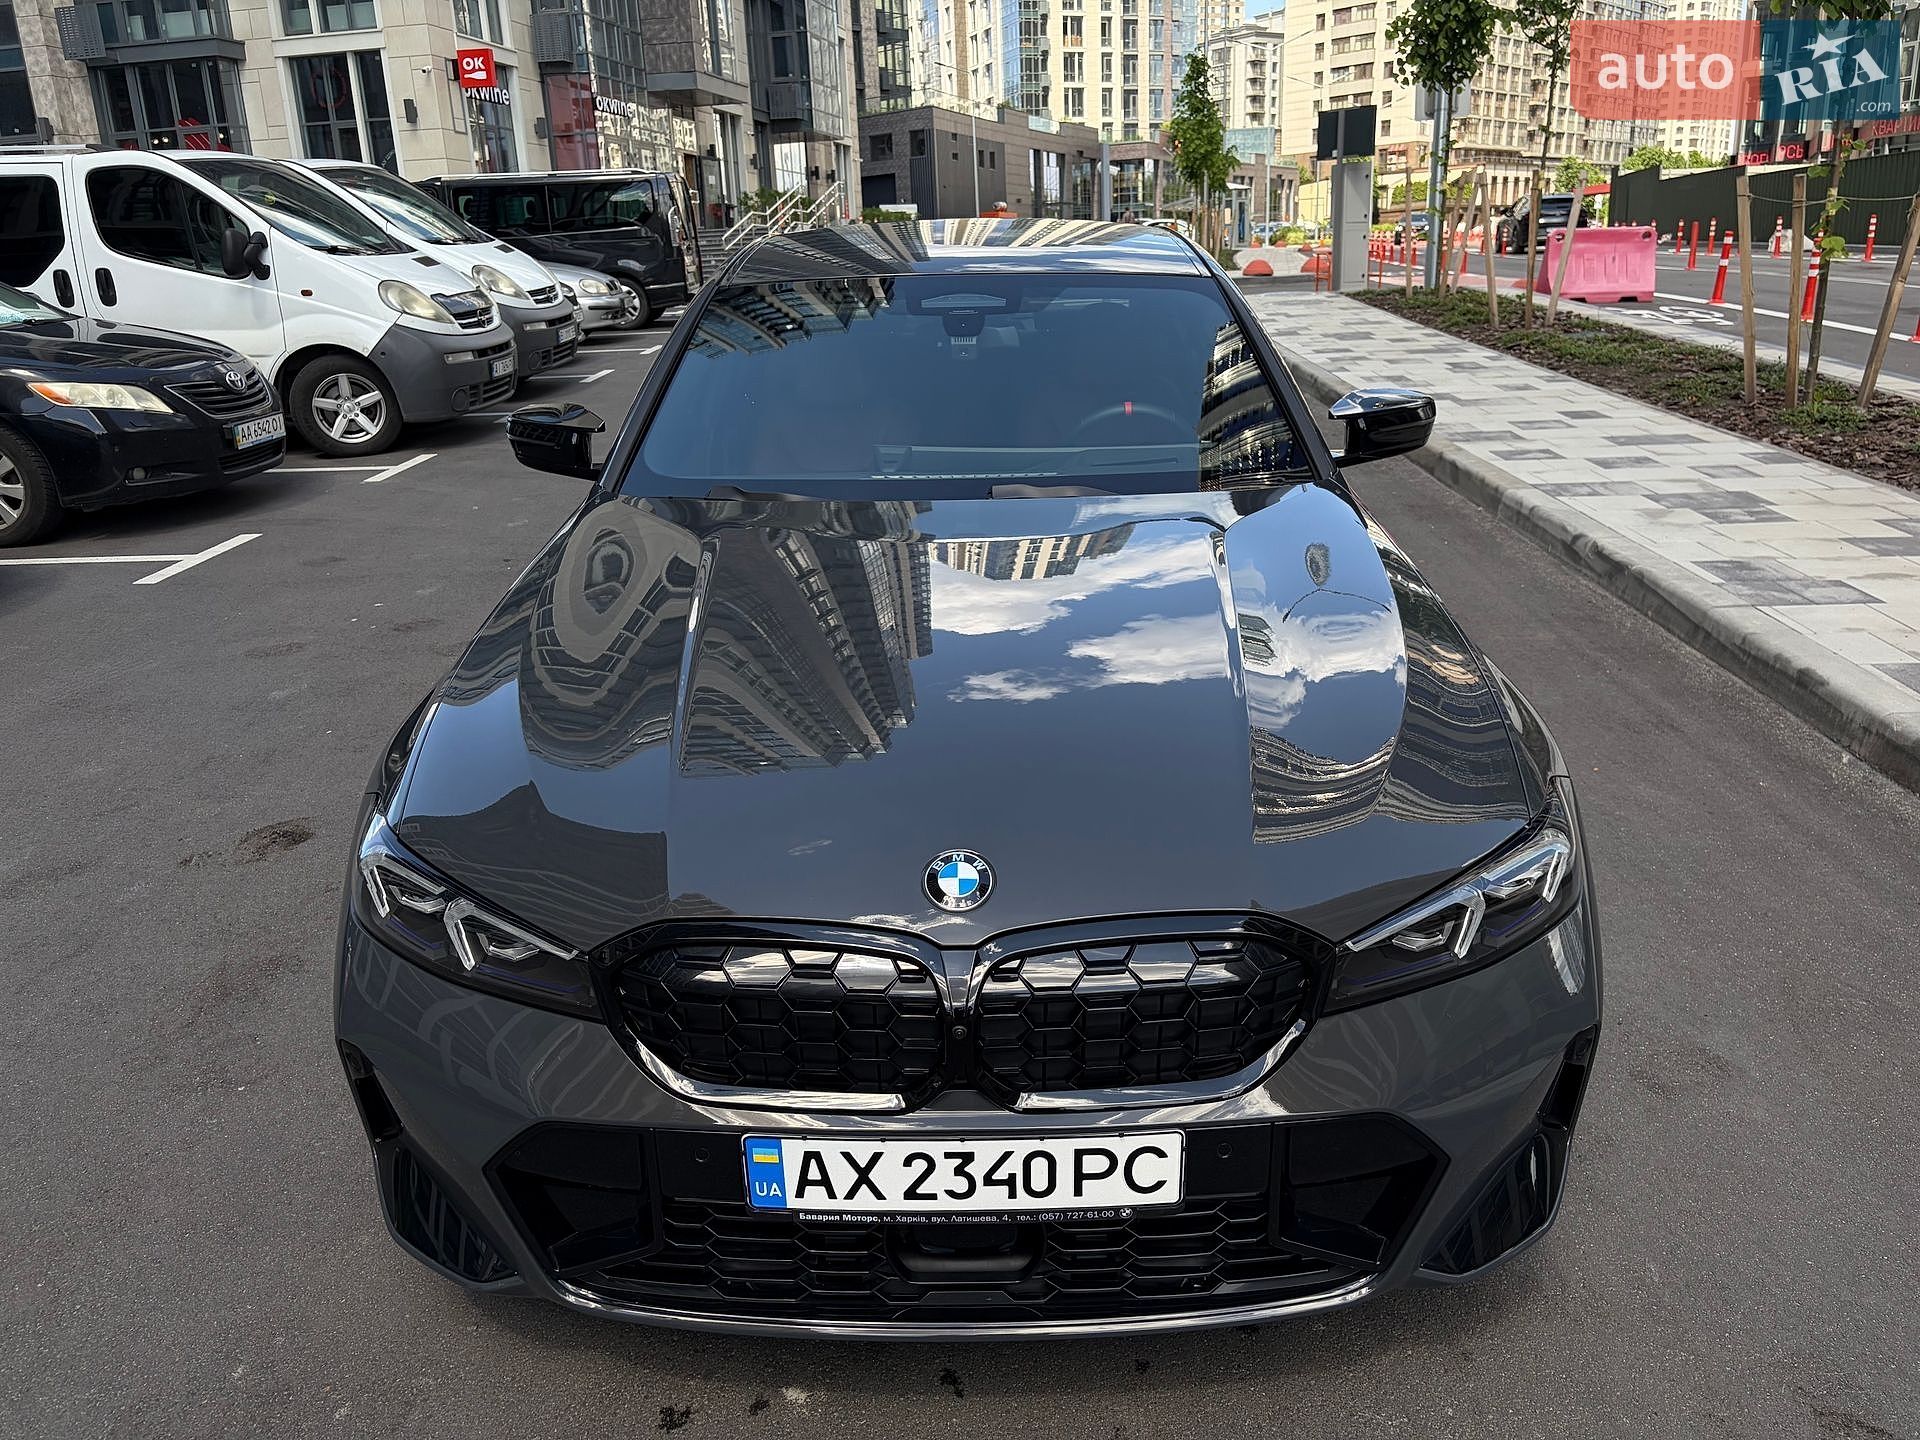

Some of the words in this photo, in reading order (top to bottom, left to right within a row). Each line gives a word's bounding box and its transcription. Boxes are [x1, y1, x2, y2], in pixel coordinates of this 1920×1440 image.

[462, 56, 486, 70] OK
[932, 854, 986, 871] BMW
[795, 1151, 887, 1200] AX
[903, 1150, 1057, 1201] 2340
[1073, 1146, 1168, 1197] PC
[755, 1181, 782, 1197] UA
[799, 1212, 840, 1222] Бавария
[842, 1213, 881, 1223] Моторс,
[895, 1214, 929, 1224] Харків,
[931, 1216, 949, 1224] вул.
[1038, 1212, 1064, 1222] (057)
[1066, 1210, 1115, 1219] 727-61-00
